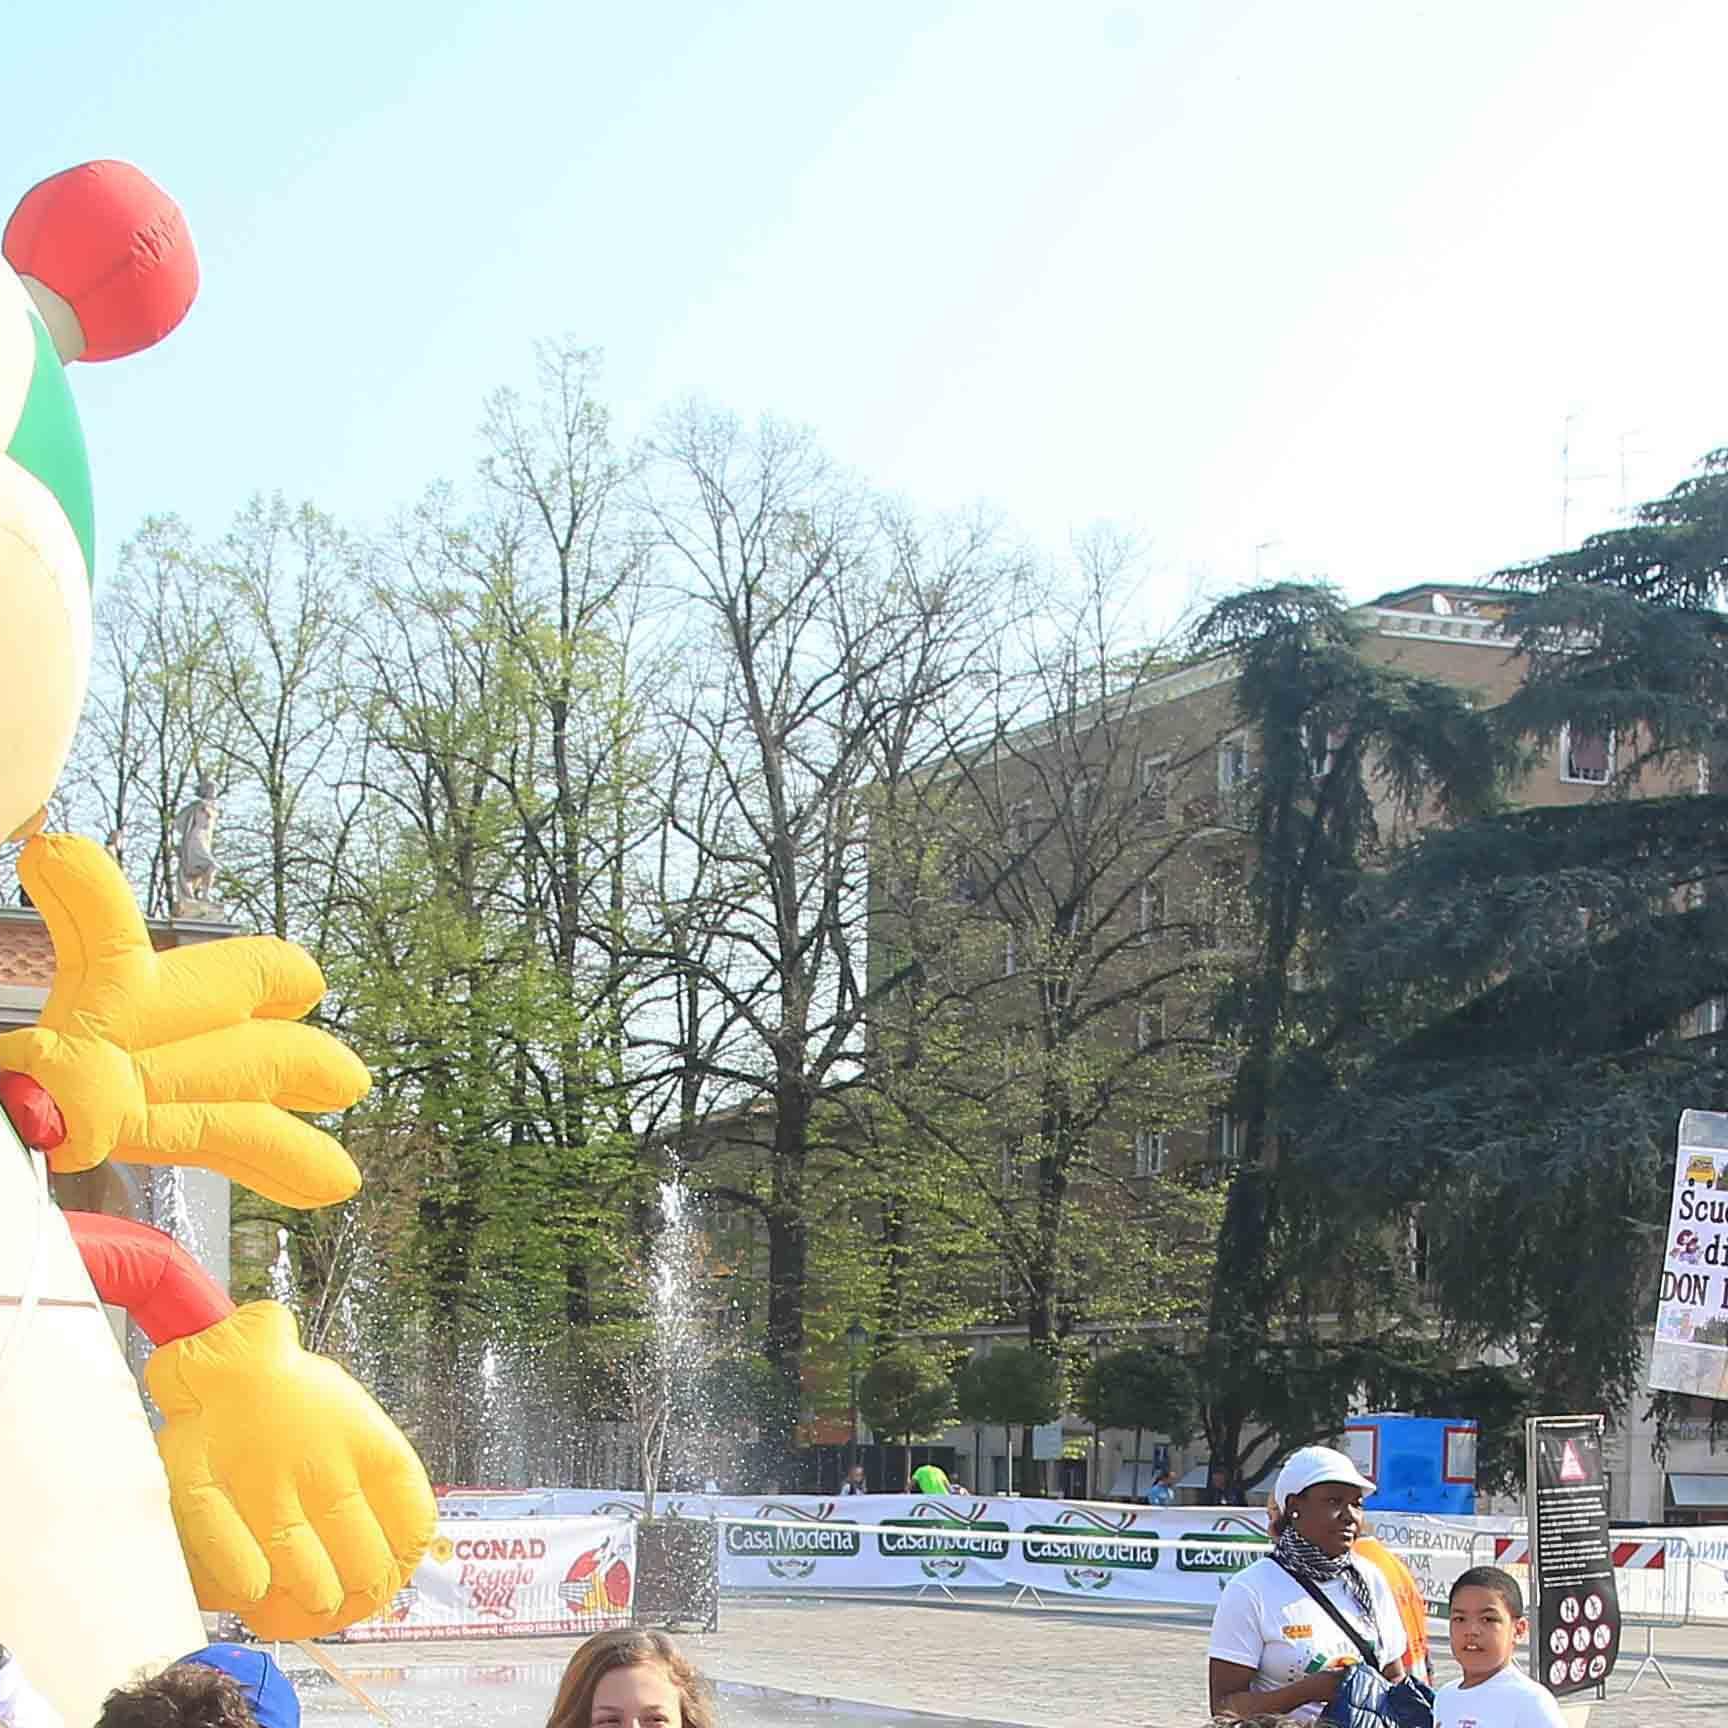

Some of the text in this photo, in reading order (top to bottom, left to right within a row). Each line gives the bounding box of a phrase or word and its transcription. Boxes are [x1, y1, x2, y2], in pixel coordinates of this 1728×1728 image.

[1659, 1271, 1708, 1306] DON
[455, 1538, 546, 1561] CONAD
[728, 1526, 855, 1551] Casa Modena
[1375, 1523, 1472, 1553] COOPERATIVA
